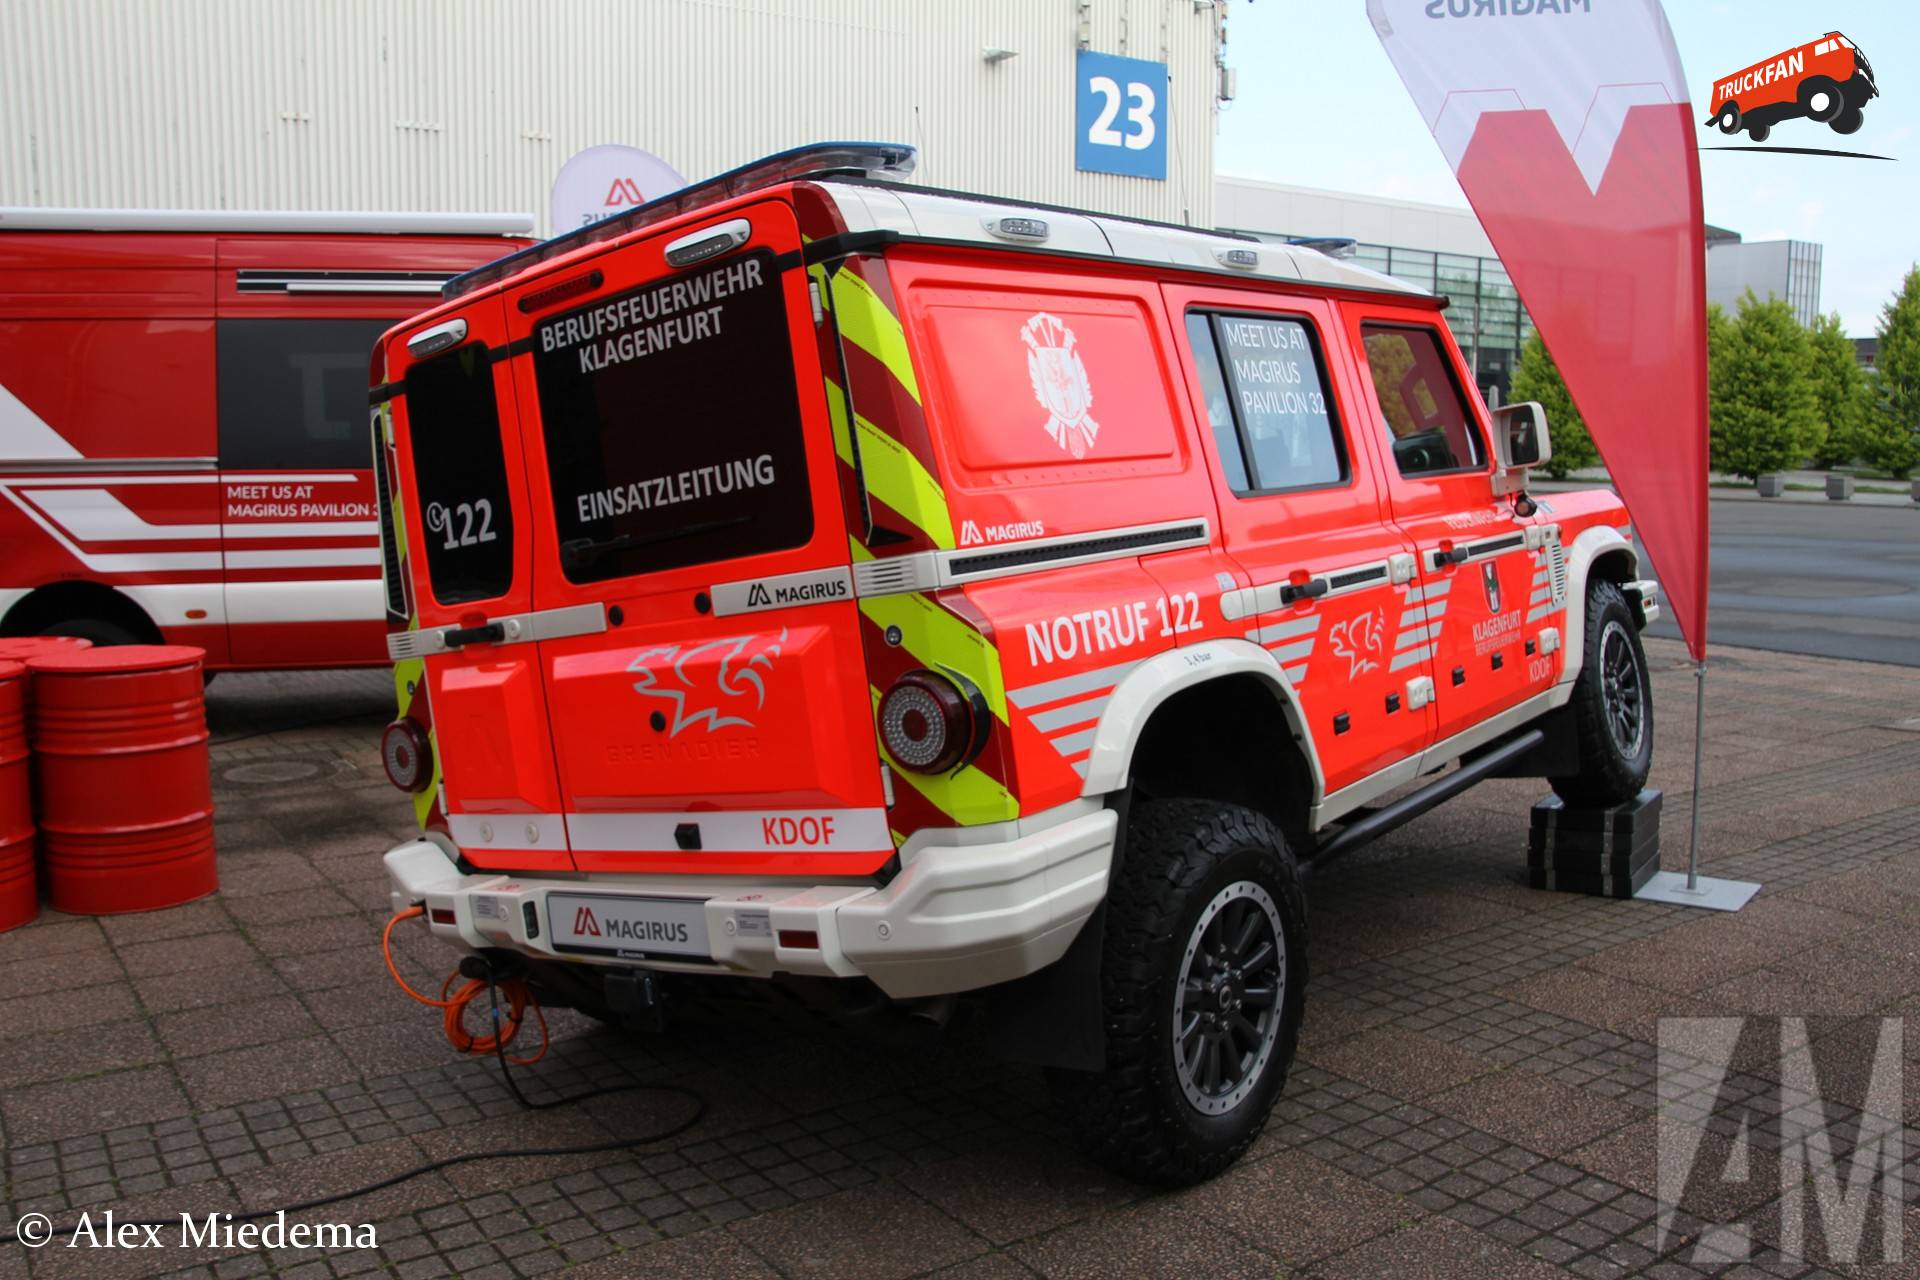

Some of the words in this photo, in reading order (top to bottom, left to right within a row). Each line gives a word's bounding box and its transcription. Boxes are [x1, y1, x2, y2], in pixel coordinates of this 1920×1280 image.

[1088, 76, 1156, 150] 23
[541, 259, 763, 352] BERUFSFEUERWEHR
[579, 306, 724, 373] KLAGENFURT
[1225, 323, 1266, 348] MEET
[1267, 325, 1288, 349] US
[1290, 327, 1304, 349] AT
[1235, 360, 1301, 384] MAGIRUS
[1243, 391, 1307, 414] PAVILION
[1309, 392, 1327, 414] 32
[227, 486, 268, 499] MEET
[271, 486, 291, 499] US
[294, 486, 313, 498] AT
[577, 454, 775, 522] EINSATZLEITUNG
[228, 503, 297, 517] MAGIRUS
[301, 503, 369, 517] PAVILION
[443, 499, 497, 550] 122
[986, 521, 1044, 541] MAGIRUS
[776, 579, 846, 604] MAGIRUS
[1025, 603, 1149, 667] NOTRUF
[1155, 592, 1203, 637] 122
[1472, 608, 1520, 642] KLAGENFURT
[606, 737, 761, 766] GRENADIER
[763, 817, 834, 845] KDOF
[605, 918, 688, 943] MAGIRUS
